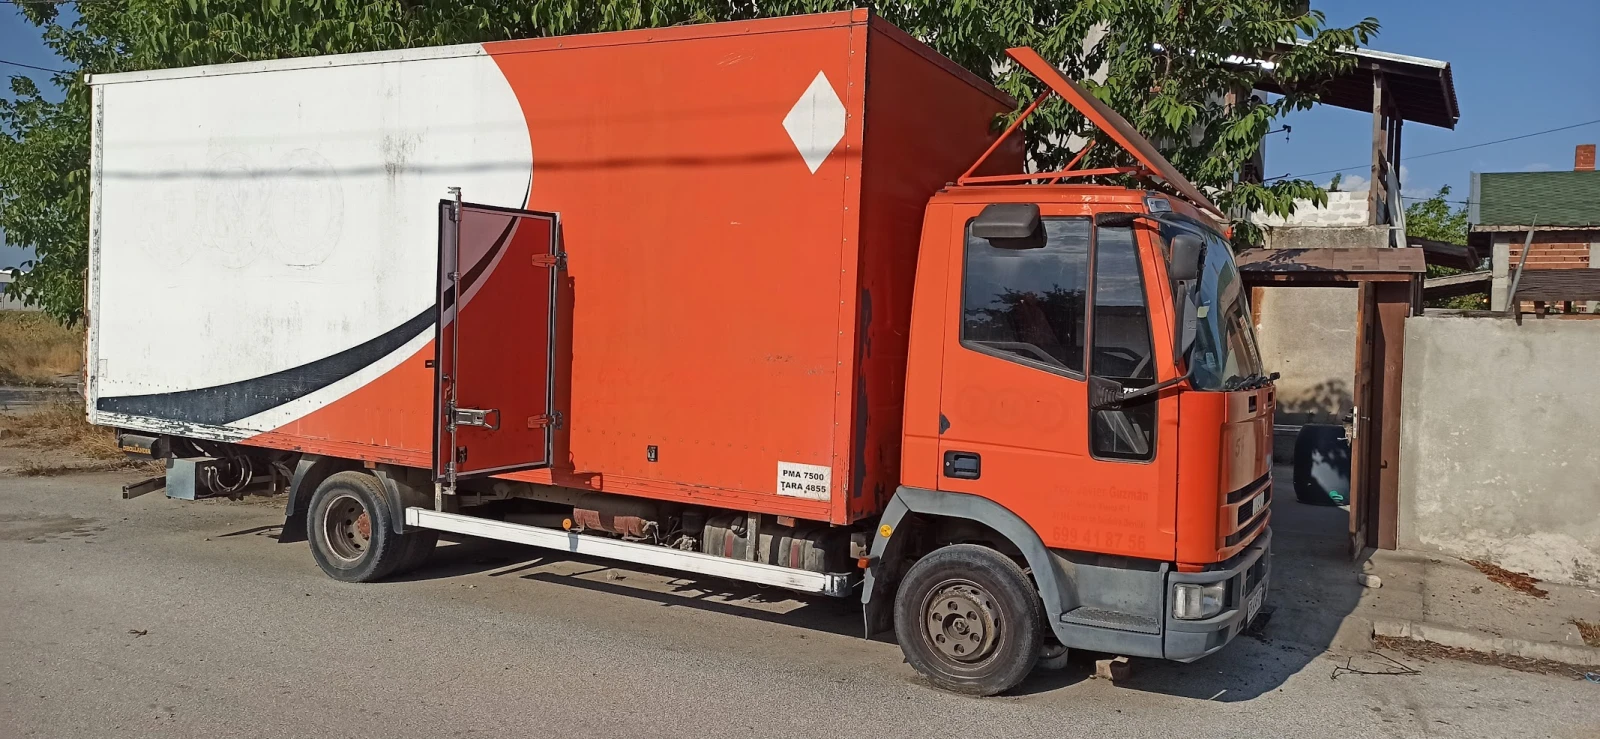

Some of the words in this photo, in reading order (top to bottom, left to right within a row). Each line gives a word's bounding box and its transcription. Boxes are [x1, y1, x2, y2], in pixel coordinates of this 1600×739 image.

[782, 469, 801, 479] PMA
[803, 471, 825, 481] 7500
[780, 480, 803, 491] TARA
[804, 484, 827, 494] 4855
[1053, 525, 1078, 543] 699
[1083, 527, 1101, 547] 41
[1105, 531, 1123, 549] 87
[1127, 533, 1147, 552] 56
